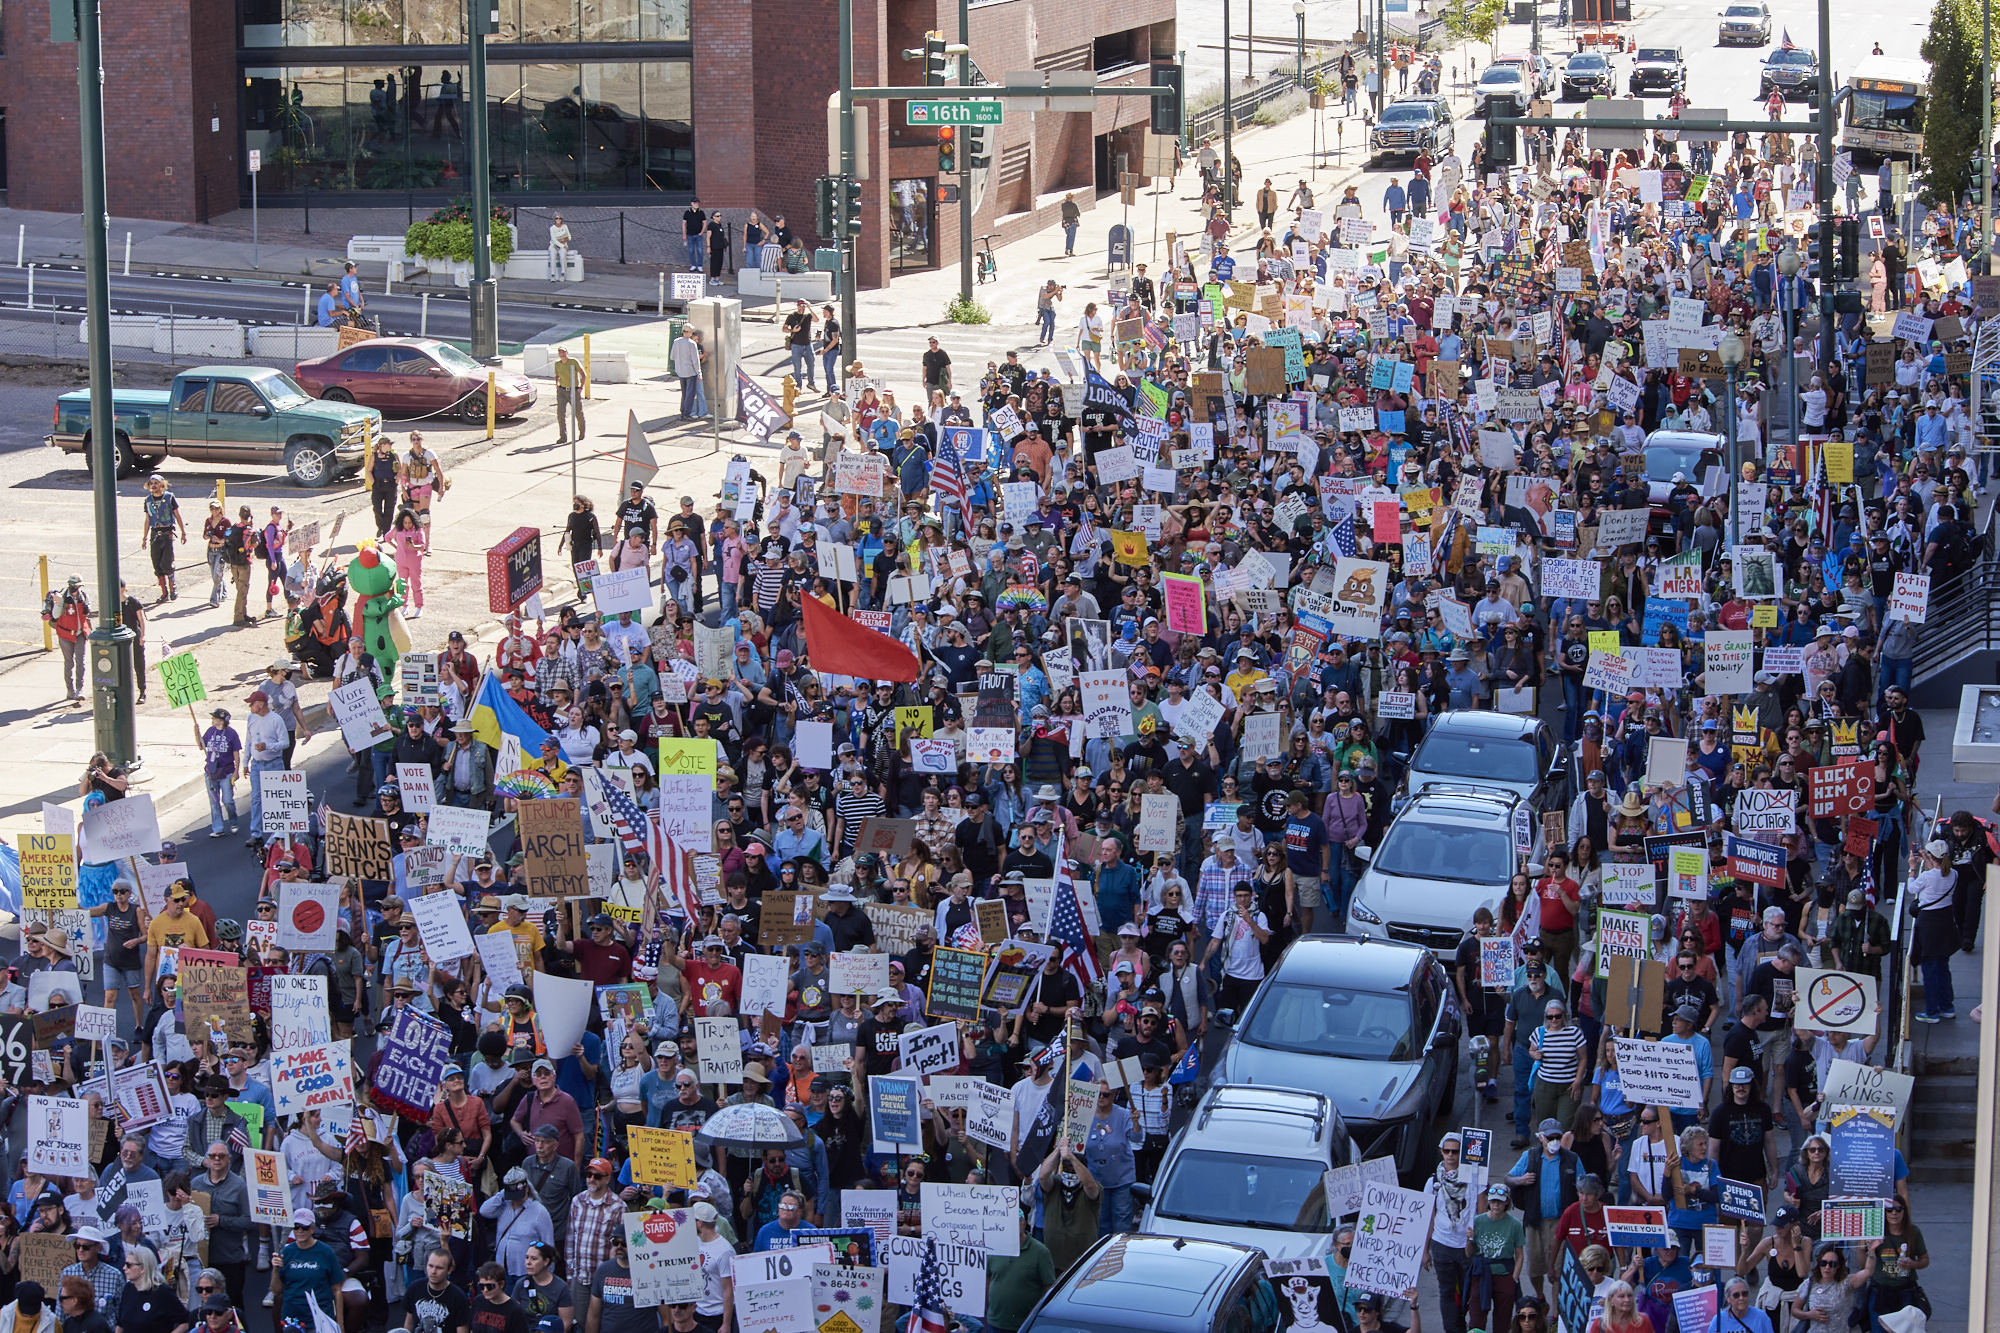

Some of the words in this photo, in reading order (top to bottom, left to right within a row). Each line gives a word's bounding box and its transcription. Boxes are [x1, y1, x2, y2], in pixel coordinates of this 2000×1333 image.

[1862, 80, 1869, 88] 16
[931, 105, 970, 121] 16th
[1767, 236, 1779, 245] STOP
[1265, 328, 1296, 338] IMPEACH
[1898, 326, 1925, 335] GERMANY
[1615, 378, 1625, 386] Our
[1625, 382, 1638, 395] Votes
[1195, 427, 1206, 436] GO
[1191, 439, 1211, 447] VOTE
[1270, 442, 1299, 450] TYRANNY
[864, 464, 878, 472] Hell
[1325, 479, 1345, 487] SAVE
[1322, 487, 1354, 495] DEMOCRACY
[1604, 515, 1628, 525] Don't
[515, 539, 537, 570] HOPE
[576, 561, 595, 573] STOP
[1543, 566, 1576, 574] ENOUGH
[1675, 567, 1692, 579] LA
[1897, 573, 1927, 587] Putin
[1663, 580, 1700, 593] MIGRA
[1898, 587, 1923, 598] Owns
[1893, 599, 1925, 616] Trump
[161, 654, 193, 674] OMG
[167, 672, 196, 691] GOP
[1084, 679, 1124, 689] POWER
[169, 687, 200, 707] WTF
[1390, 695, 1409, 703] STOP
[906, 709, 919, 718] NO
[1085, 709, 1131, 724] SOLIDARITY
[281, 773, 302, 783] AND
[404, 767, 425, 777] VOTE
[1814, 767, 1855, 783] LOCK
[404, 782, 429, 791] DAMN
[1814, 784, 1847, 799] HIM
[264, 789, 292, 798] THEN
[413, 795, 428, 804] IT!
[280, 800, 306, 809] THEY
[1146, 797, 1168, 809] YOUR
[1692, 783, 1704, 821] RESIST
[1740, 791, 1766, 810] NO
[522, 802, 575, 821] TRUMP
[1146, 808, 1168, 818] VOTE
[1815, 801, 1834, 815] UP
[263, 811, 291, 820] CAME
[1740, 812, 1792, 830] DICTATOR
[264, 822, 285, 831] FOR
[289, 821, 307, 831] ME!
[331, 815, 377, 837] BAN
[1144, 825, 1168, 837] YOUR
[31, 835, 56, 849] NO
[1144, 835, 1168, 845] POWER
[328, 835, 391, 859] BENNYS
[525, 835, 580, 858] ARCH
[20, 852, 73, 863] AMERICAN
[1736, 844, 1756, 859] YOUR
[1757, 849, 1778, 864] VOICE
[22, 865, 52, 875] LIVES
[57, 865, 71, 875] TO
[330, 857, 388, 878] BITCH
[1614, 868, 1645, 876] STOP
[1735, 860, 1756, 874] YOUR
[1757, 862, 1778, 879] VOTE
[22, 877, 72, 886] COVER-UP
[531, 876, 585, 896] ENEMY
[1618, 880, 1638, 888] THE
[22, 886, 77, 897] TRUMPSTEIN
[1603, 892, 1654, 903] MADNESS!
[35, 897, 65, 908] LIES
[604, 905, 639, 921] VOTE
[1602, 917, 1638, 933] MAKE
[1602, 931, 1642, 947] NAZIS
[1483, 942, 1499, 950] NO
[1601, 945, 1647, 959] AFRAID
[1482, 950, 1512, 959] KINGS
[274, 978, 286, 989] NO
[292, 978, 308, 990] ONE
[309, 980, 318, 991] IS
[747, 975, 778, 988] BOO
[79, 1011, 113, 1025] VOTES
[77, 1022, 116, 1035] MATTER
[701, 1020, 738, 1038] TRUMP
[390, 1012, 451, 1064] LOVE
[876, 1032, 898, 1042] ICE
[876, 1042, 898, 1052] OUT
[288, 1048, 328, 1070] MAKE
[388, 1047, 434, 1078] EACH
[701, 1058, 742, 1074] TRAITOR
[278, 1063, 330, 1082] AMERICA
[1621, 1068, 1642, 1077] SEND
[1672, 1072, 1698, 1081] SENATE
[1856, 1069, 1883, 1087] NO
[295, 1075, 334, 1093] GOOD
[378, 1064, 438, 1105] OTHER
[877, 1082, 909, 1095] TYRANNY
[973, 1081, 983, 1090] THE
[984, 1085, 999, 1096] ONLY
[1000, 1091, 1011, 1099] ICE
[306, 1077, 353, 1106] AGAIN!
[1840, 1085, 1894, 1104] KINGS
[37, 1098, 49, 1106] NO
[56, 1100, 80, 1109] KINGS
[880, 1094, 906, 1102] CANNOT
[881, 1101, 907, 1109] PREVAIL
[969, 1121, 1006, 1141] DIAMOND
[260, 1169, 273, 1179] NO
[1726, 1186, 1753, 1198] DEFEND
[1735, 1197, 1747, 1206] THE
[255, 1208, 287, 1217] AMERICA
[1721, 1204, 1764, 1218] CONSTITUTION
[645, 1223, 674, 1233] STARTS
[1616, 1224, 1638, 1233] WHILE
[1641, 1225, 1657, 1233] YOU
[1357, 1235, 1384, 1253] WIERD
[1385, 1240, 1420, 1261] POLICY
[657, 1257, 696, 1267] TRUMP!
[816, 1268, 832, 1278] NO
[836, 1270, 875, 1280] KINGS!
[746, 1289, 784, 1301] IMPEACH
[750, 1302, 780, 1313] INDICT
[743, 1314, 796, 1327] INCARCERATE
